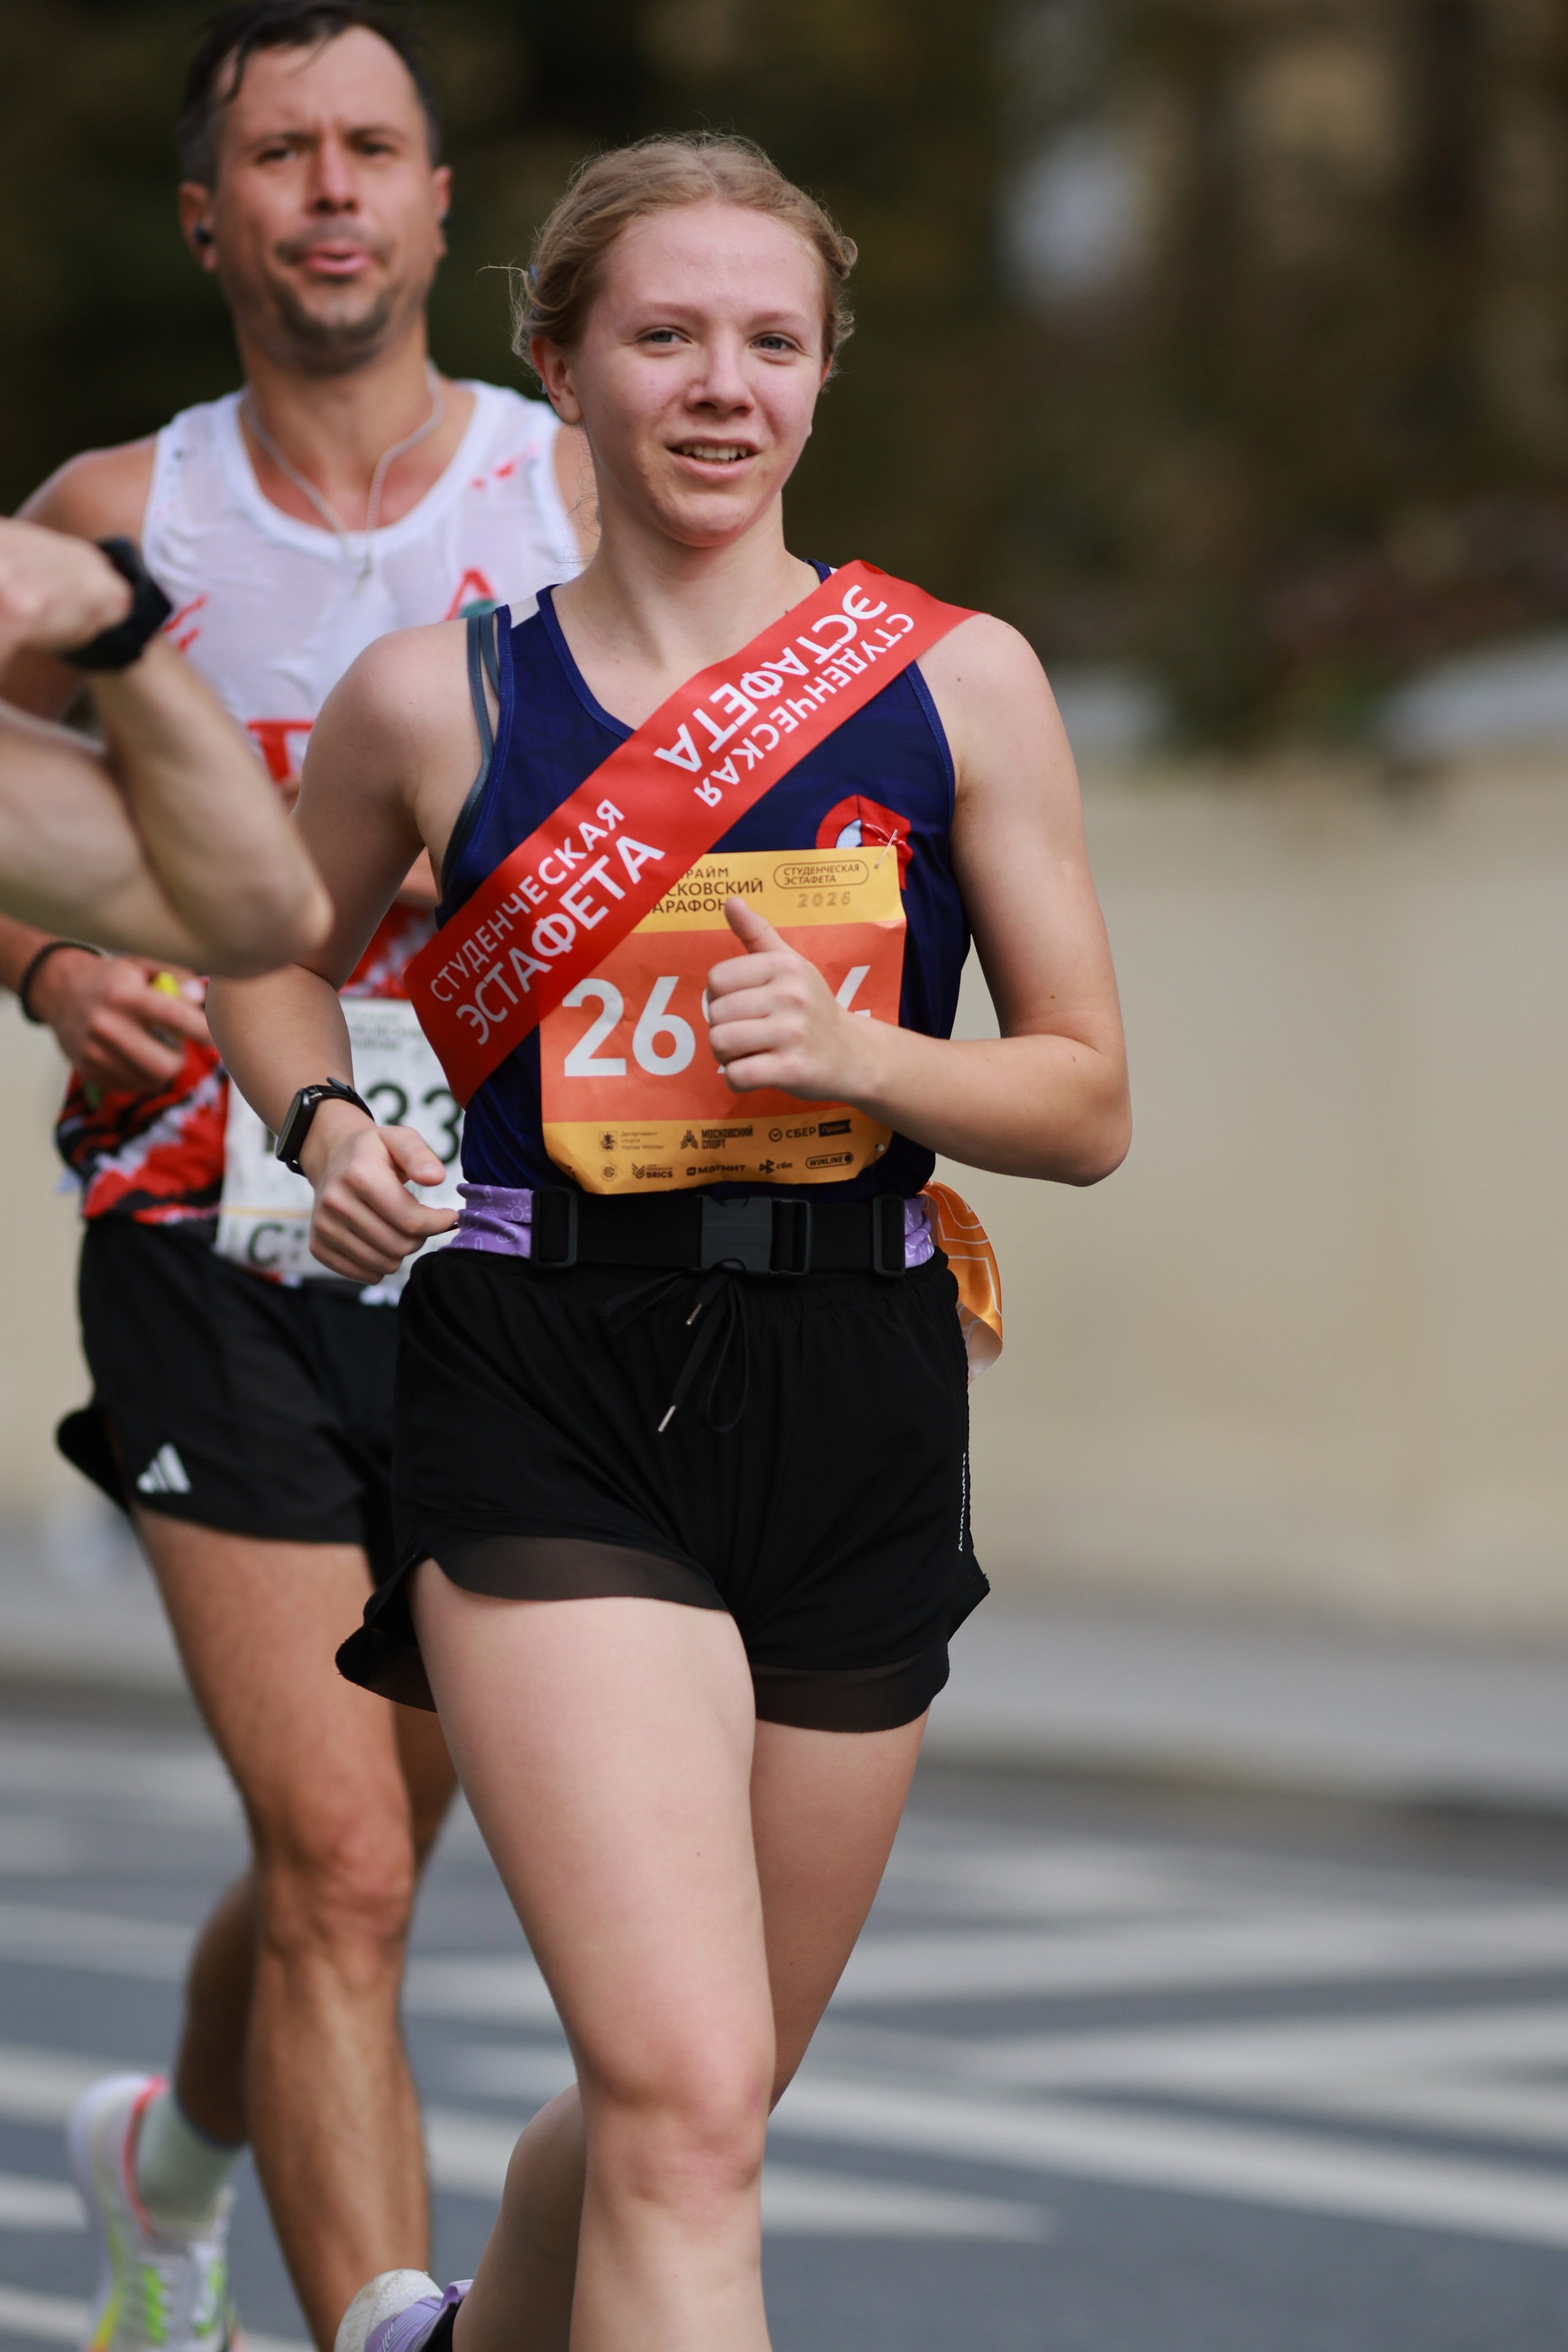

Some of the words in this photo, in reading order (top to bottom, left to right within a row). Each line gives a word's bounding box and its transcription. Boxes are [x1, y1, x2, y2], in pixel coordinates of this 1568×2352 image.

[653, 584, 888, 772] ЭСТАФЕТА
[693, 613, 914, 807] СТУДЕНЧЕСКАЯ
[682, 866, 729, 878] РАЙМ
[783, 864, 859, 876] СТУДЕНЧЕСКАЯ
[784, 875, 835, 885] ЭСТАФЕТА
[430, 799, 625, 1001] СТУДЕНЧЕСКАЯ
[648, 898, 726, 913] АРАФОН
[797, 891, 851, 908] 2026
[456, 835, 666, 1045] ЭСТАФЕТА
[701, 1125, 753, 1139] МОСКОВСКИЙ
[786, 1127, 816, 1139] СБЕР
[701, 1139, 726, 1149] СПОРТ
[809, 1155, 843, 1166] WINLINE
